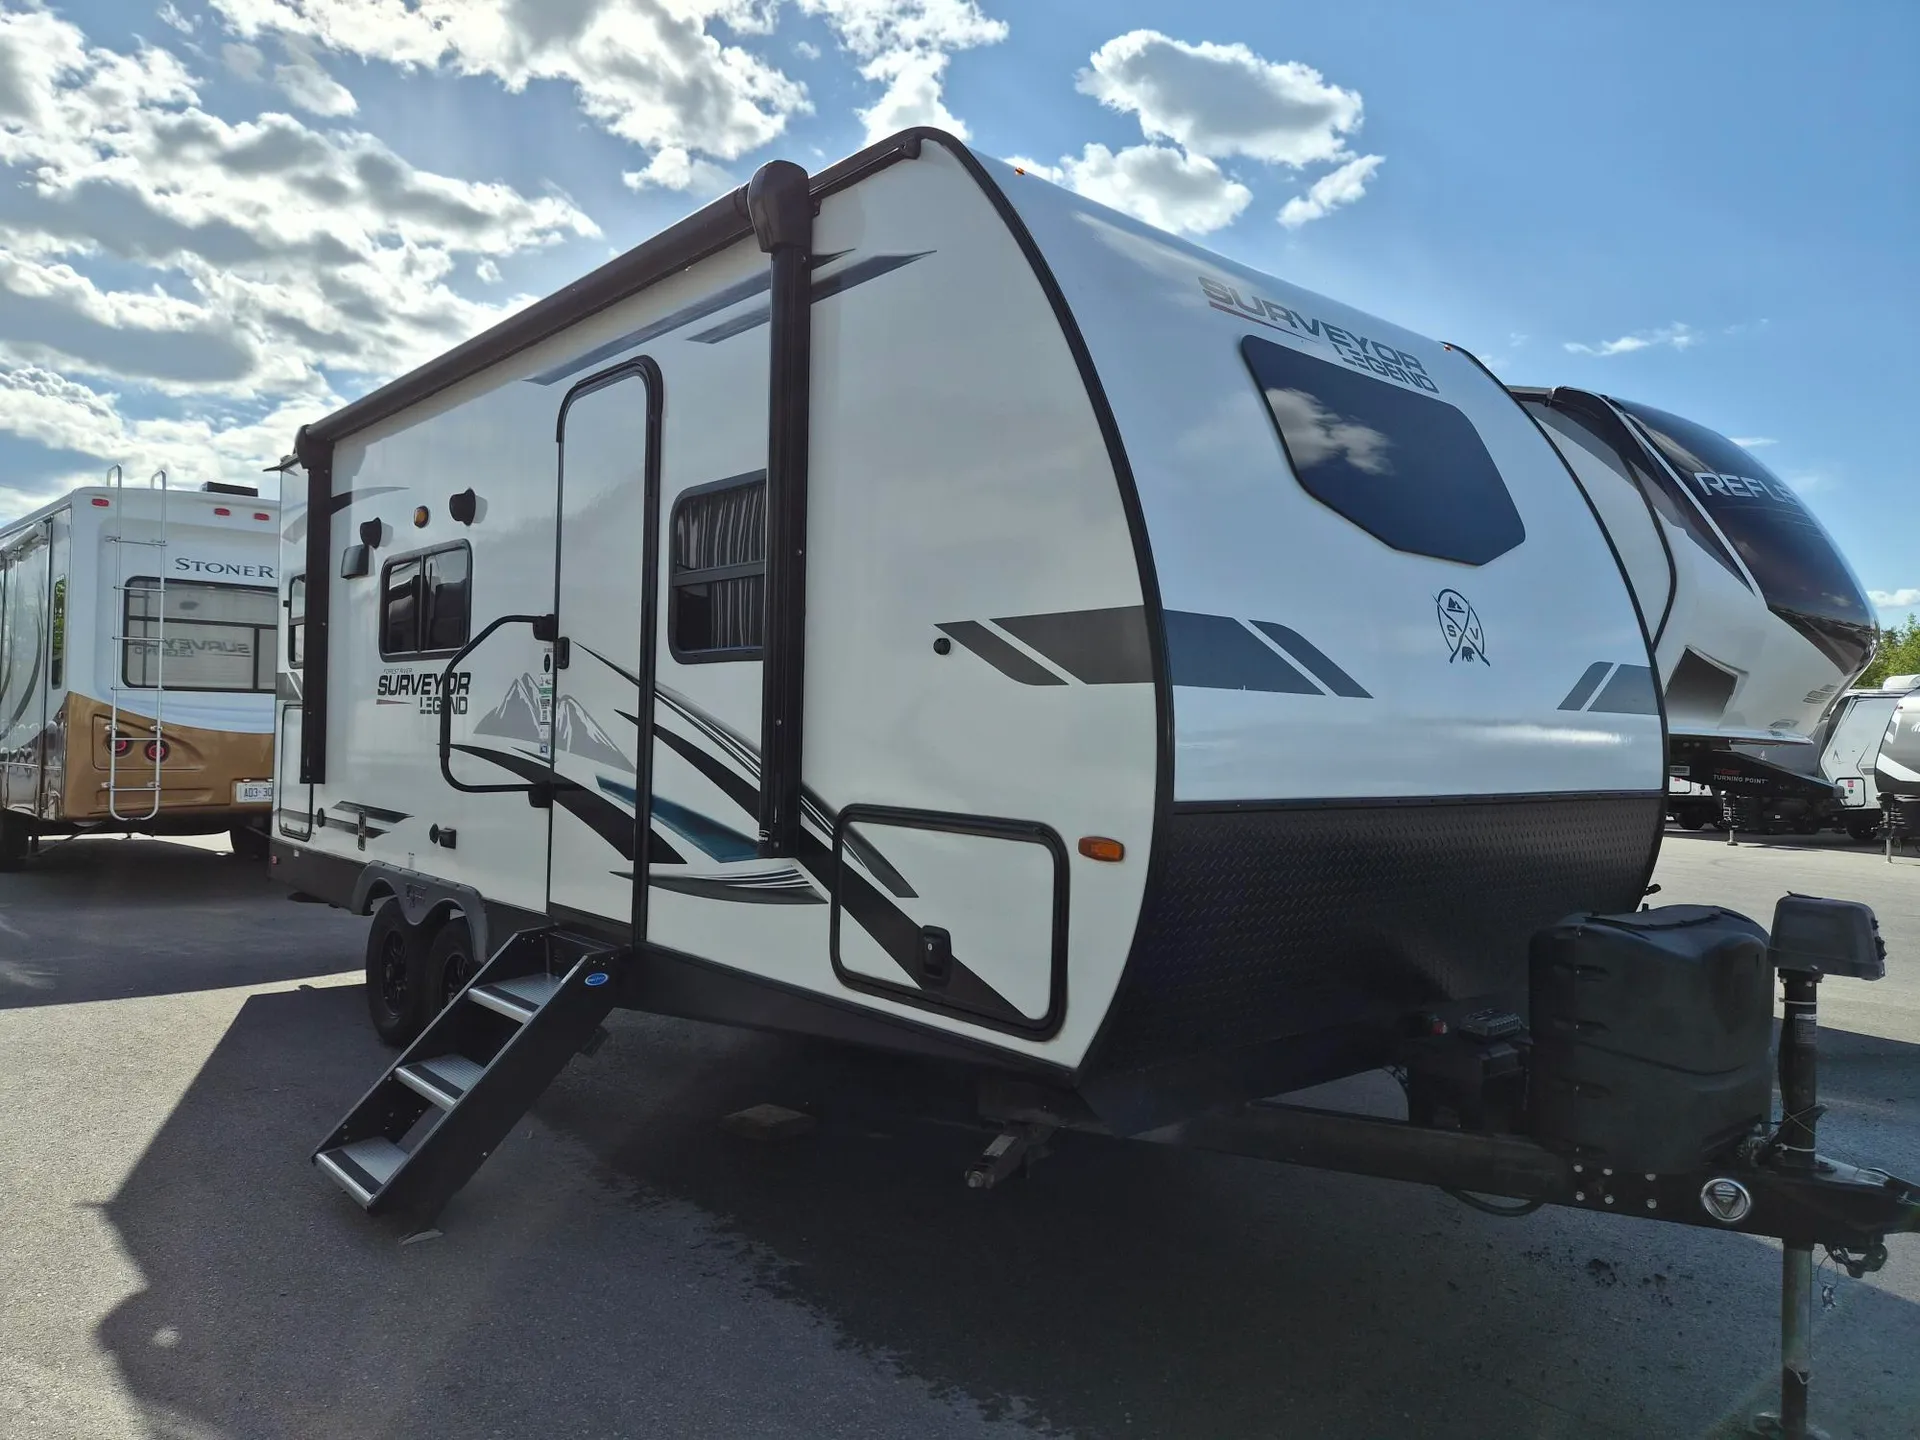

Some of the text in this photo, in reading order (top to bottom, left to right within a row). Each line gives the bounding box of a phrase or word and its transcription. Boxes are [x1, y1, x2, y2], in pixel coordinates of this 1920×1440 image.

[1198, 277, 1428, 375] SURVEYOR
[1332, 343, 1440, 394] LEGEND
[175, 557, 275, 579] STONER
[377, 672, 471, 696] SURVEYOR
[420, 696, 468, 715] LEGND
